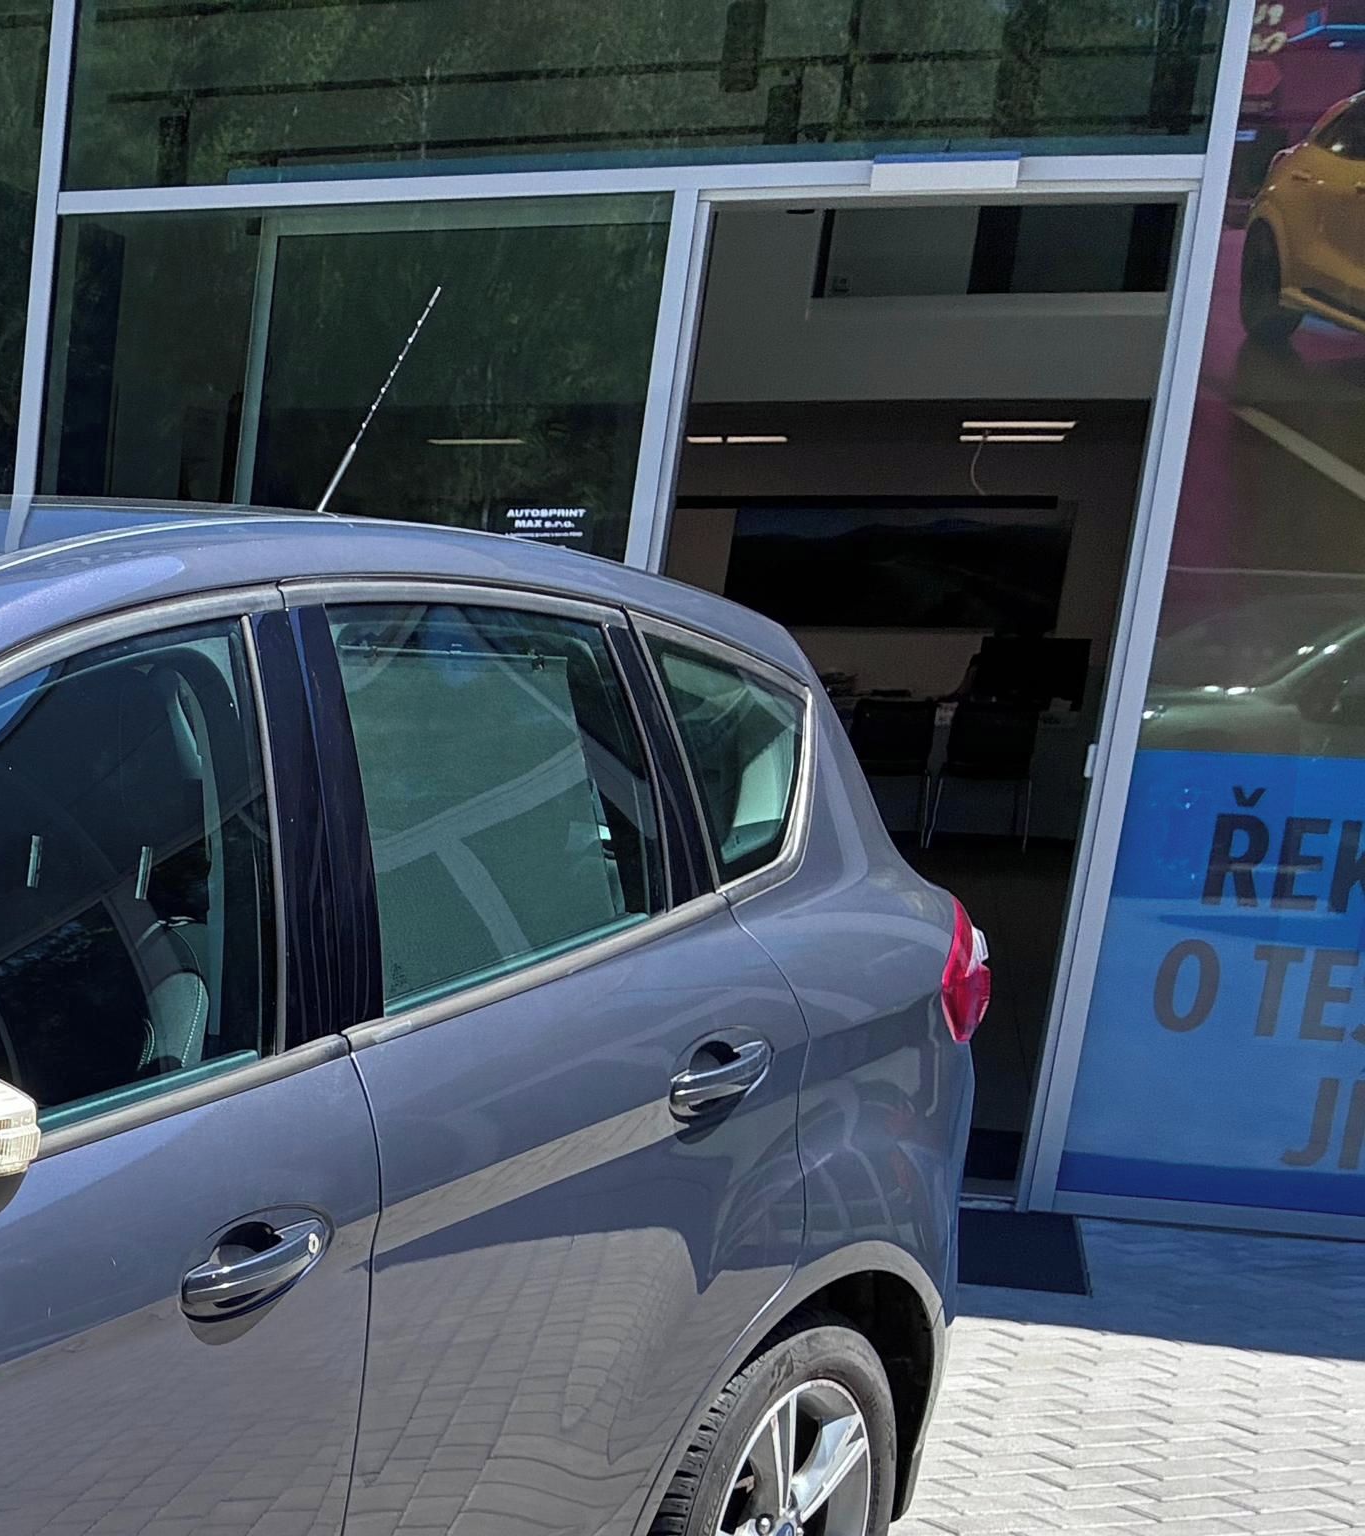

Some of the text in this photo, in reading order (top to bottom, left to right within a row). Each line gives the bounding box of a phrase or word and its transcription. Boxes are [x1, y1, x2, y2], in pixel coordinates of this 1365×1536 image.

[506, 508, 587, 518] AUTOSPRINT
[514, 519, 543, 528] MAX
[1153, 939, 1365, 1045] O TE
